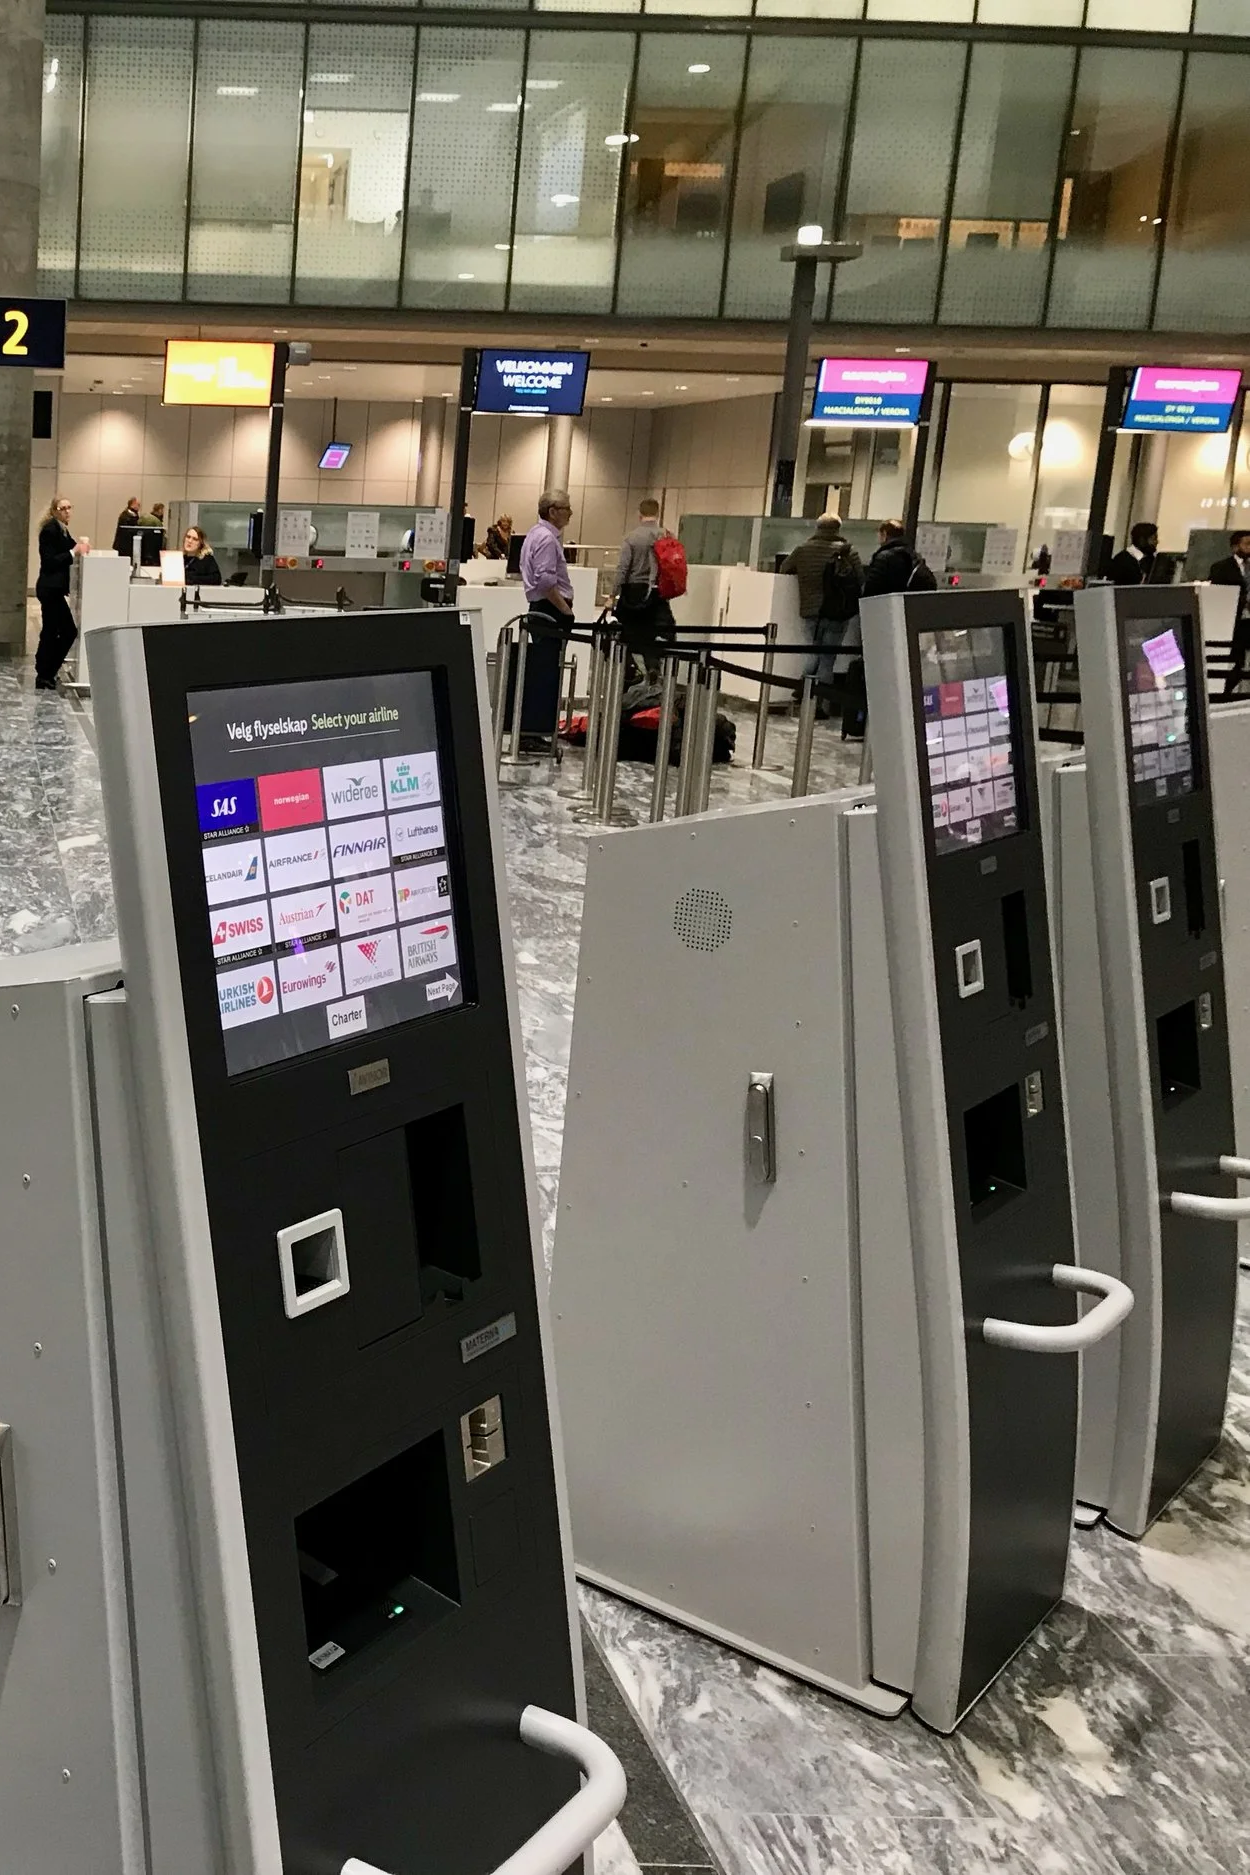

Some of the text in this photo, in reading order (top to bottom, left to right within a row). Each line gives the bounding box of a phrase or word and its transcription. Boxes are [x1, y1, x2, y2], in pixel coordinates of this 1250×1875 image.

[2, 310, 29, 356] 2
[495, 359, 574, 375] VELKOMMEN
[502, 374, 563, 389] WELCOME
[227, 706, 399, 742] Velg flyselskap Select your airline
[390, 777, 419, 794] KLM
[274, 793, 309, 805] norwegian
[331, 785, 378, 804] widerøe
[211, 796, 237, 817] SAS
[203, 827, 244, 840] STAR ALLIANCE
[407, 825, 438, 838] Lufthansa
[333, 836, 386, 858] FINNAIR
[400, 851, 433, 863] STAR ALLIANCE
[205, 869, 243, 883] CELANDAIR
[355, 889, 374, 906] DAT
[279, 908, 315, 925] Austrian
[228, 917, 263, 938] SWISS
[407, 940, 437, 957] BRITISH
[217, 950, 257, 966] STAR ALLIANCE
[407, 952, 438, 969] AIRWAYS
[219, 982, 255, 1001] URKISH
[282, 974, 326, 994] Eurowings
[427, 982, 456, 996] Next Page
[221, 995, 257, 1014] IRLINES
[331, 1009, 362, 1027] Charter
